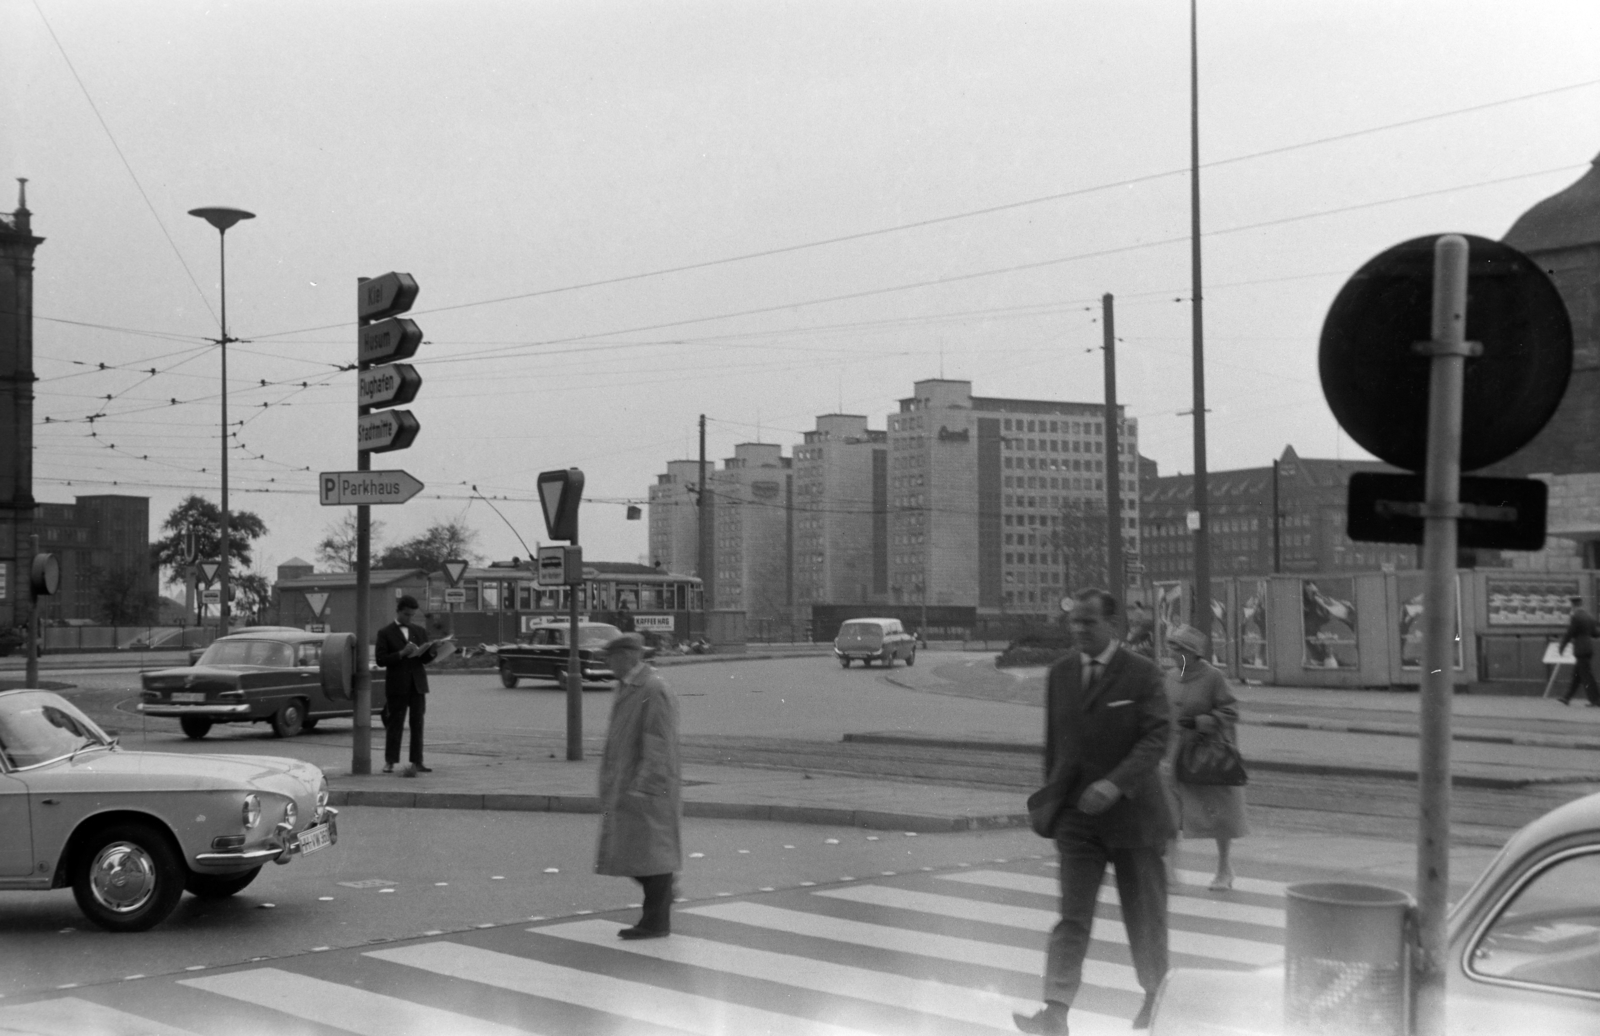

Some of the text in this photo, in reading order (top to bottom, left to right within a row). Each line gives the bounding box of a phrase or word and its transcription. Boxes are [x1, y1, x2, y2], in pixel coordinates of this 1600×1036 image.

[367, 284, 383, 306] Kiel
[364, 331, 391, 352] Husum
[359, 374, 394, 399] Flughafen
[358, 419, 392, 442] Stadtmitte
[325, 478, 400, 501] P Parkhaus
[636, 617, 670, 625] KAFFEE HAG
